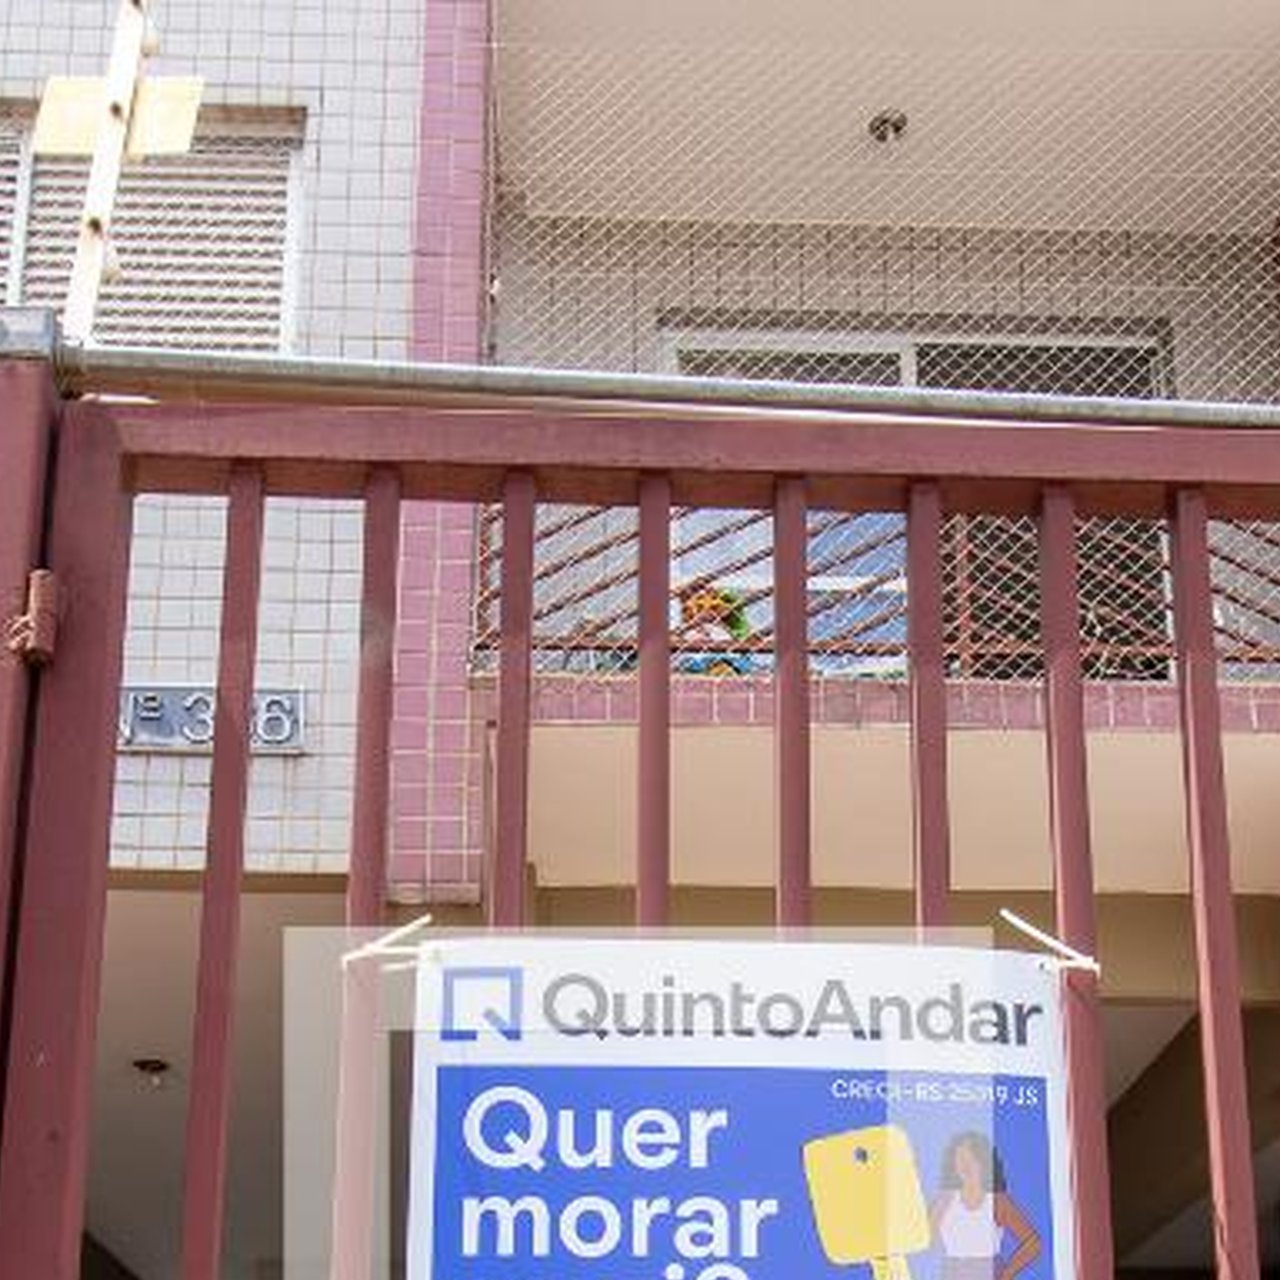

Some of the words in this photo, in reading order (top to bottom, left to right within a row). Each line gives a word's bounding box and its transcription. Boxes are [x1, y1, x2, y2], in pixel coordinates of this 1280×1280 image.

[183, 691, 292, 744] 36
[542, 973, 1044, 1047] QuintoAndar
[463, 1085, 729, 1174] Quer
[461, 1194, 780, 1259] morar
